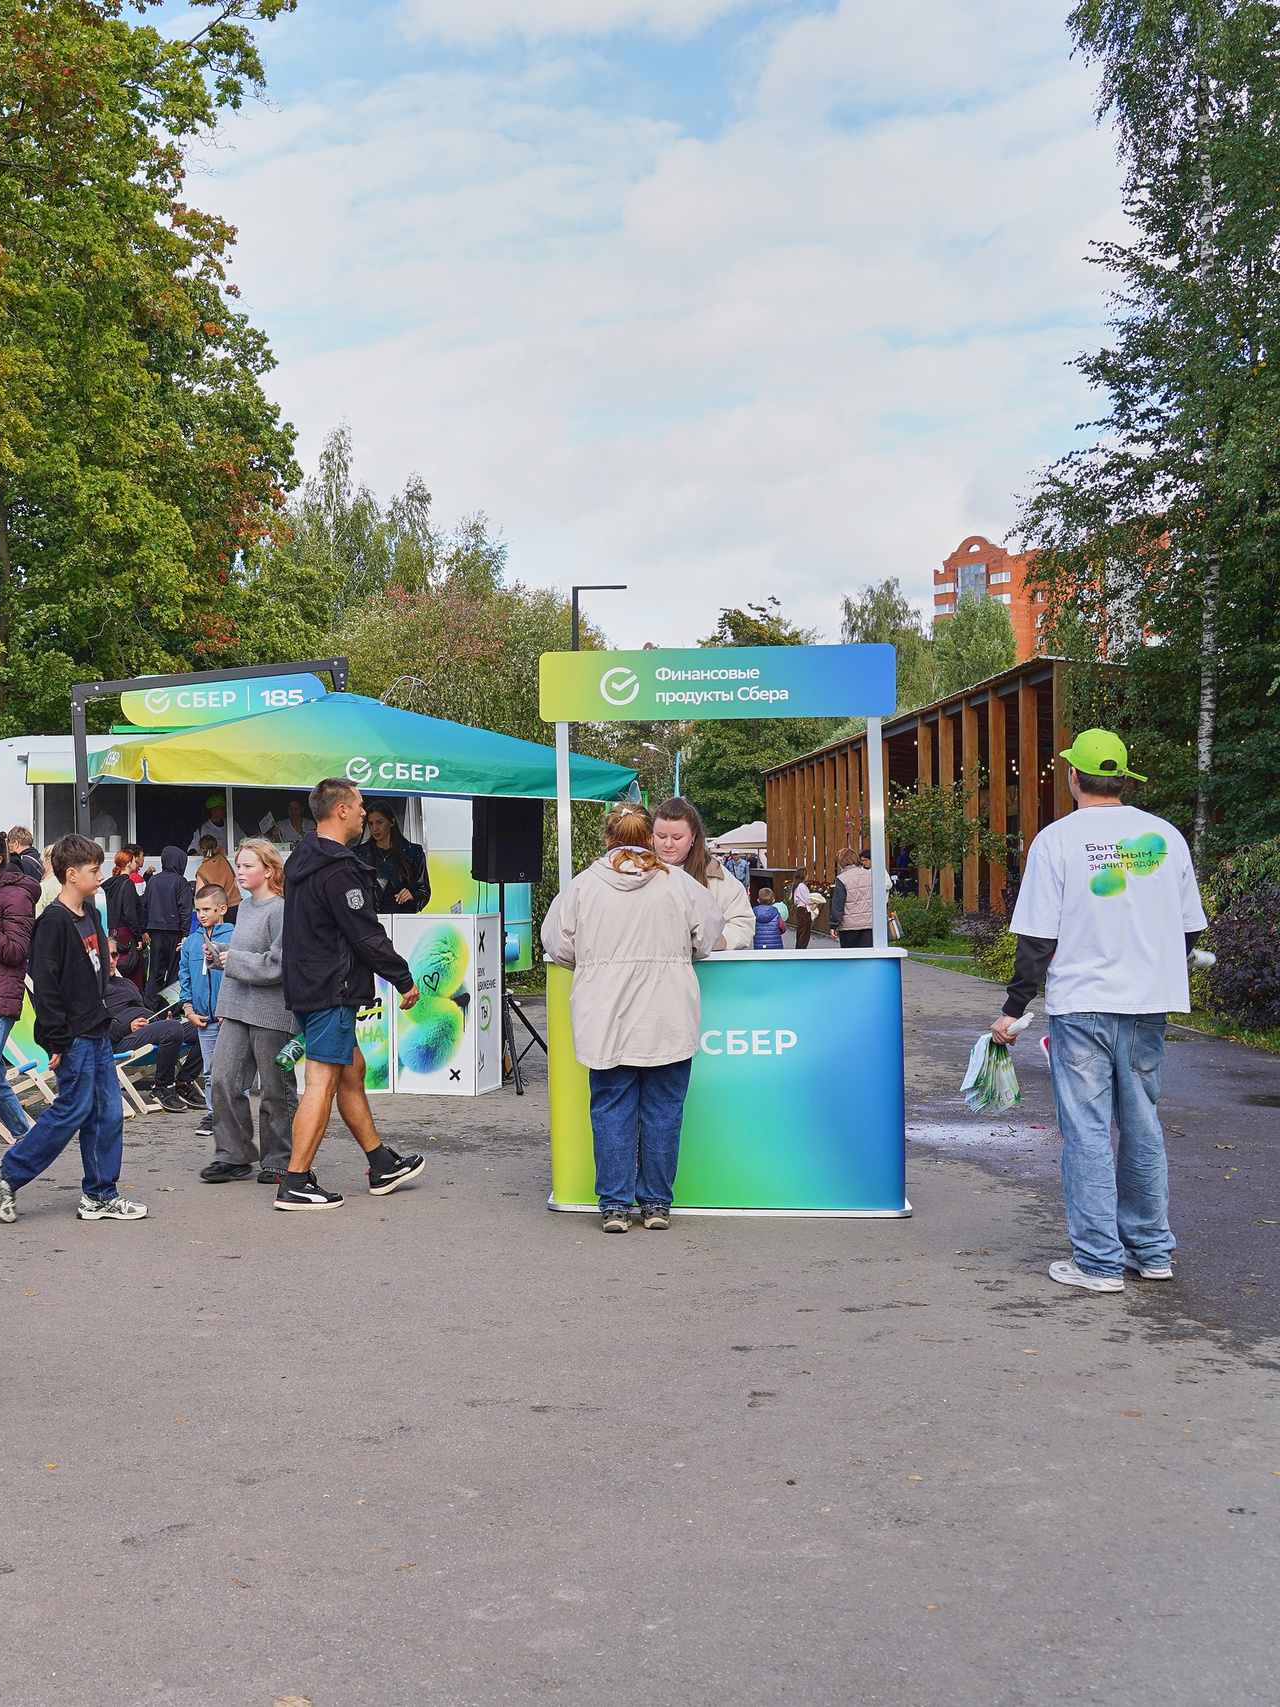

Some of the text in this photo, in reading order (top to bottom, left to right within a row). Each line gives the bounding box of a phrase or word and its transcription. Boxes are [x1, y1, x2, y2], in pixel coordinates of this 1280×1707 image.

[655, 667, 760, 681] Финансовые
[176, 689, 304, 708] СБЕР 185
[655, 686, 789, 705] продукты Сбера
[378, 762, 440, 782] СБЕР
[1085, 843, 1123, 852] Быть
[1087, 850, 1153, 861] зелёным
[1089, 859, 1159, 871] значит рядом
[700, 1030, 798, 1055] СБЕР
